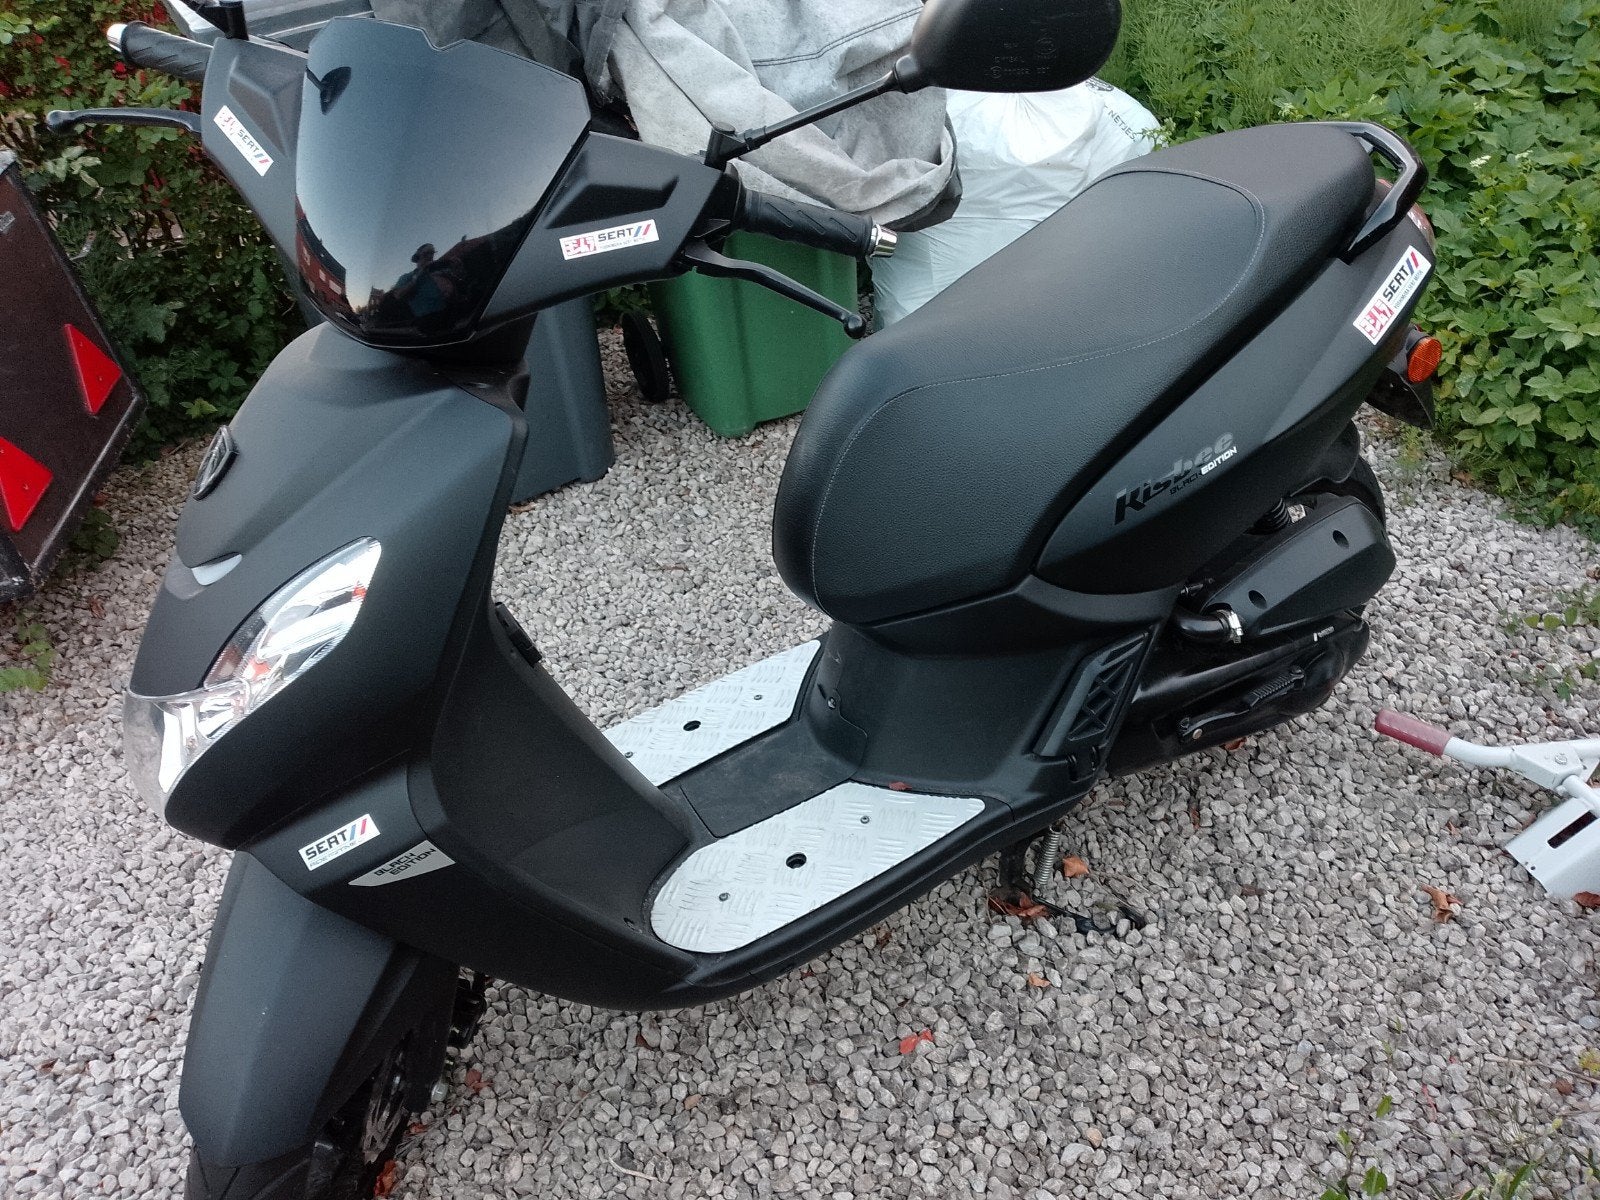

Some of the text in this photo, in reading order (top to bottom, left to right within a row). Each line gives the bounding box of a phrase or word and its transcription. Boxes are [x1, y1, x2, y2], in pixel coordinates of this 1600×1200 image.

[236, 129, 260, 154] SERT
[597, 226, 635, 242] SERT
[1382, 266, 1411, 302] SERT
[1114, 432, 1234, 525] Kisbee
[1169, 446, 1237, 495] BLACK EDITION
[304, 829, 348, 860] SERT
[374, 852, 417, 877] BLACK
[391, 848, 437, 876] EDITION
